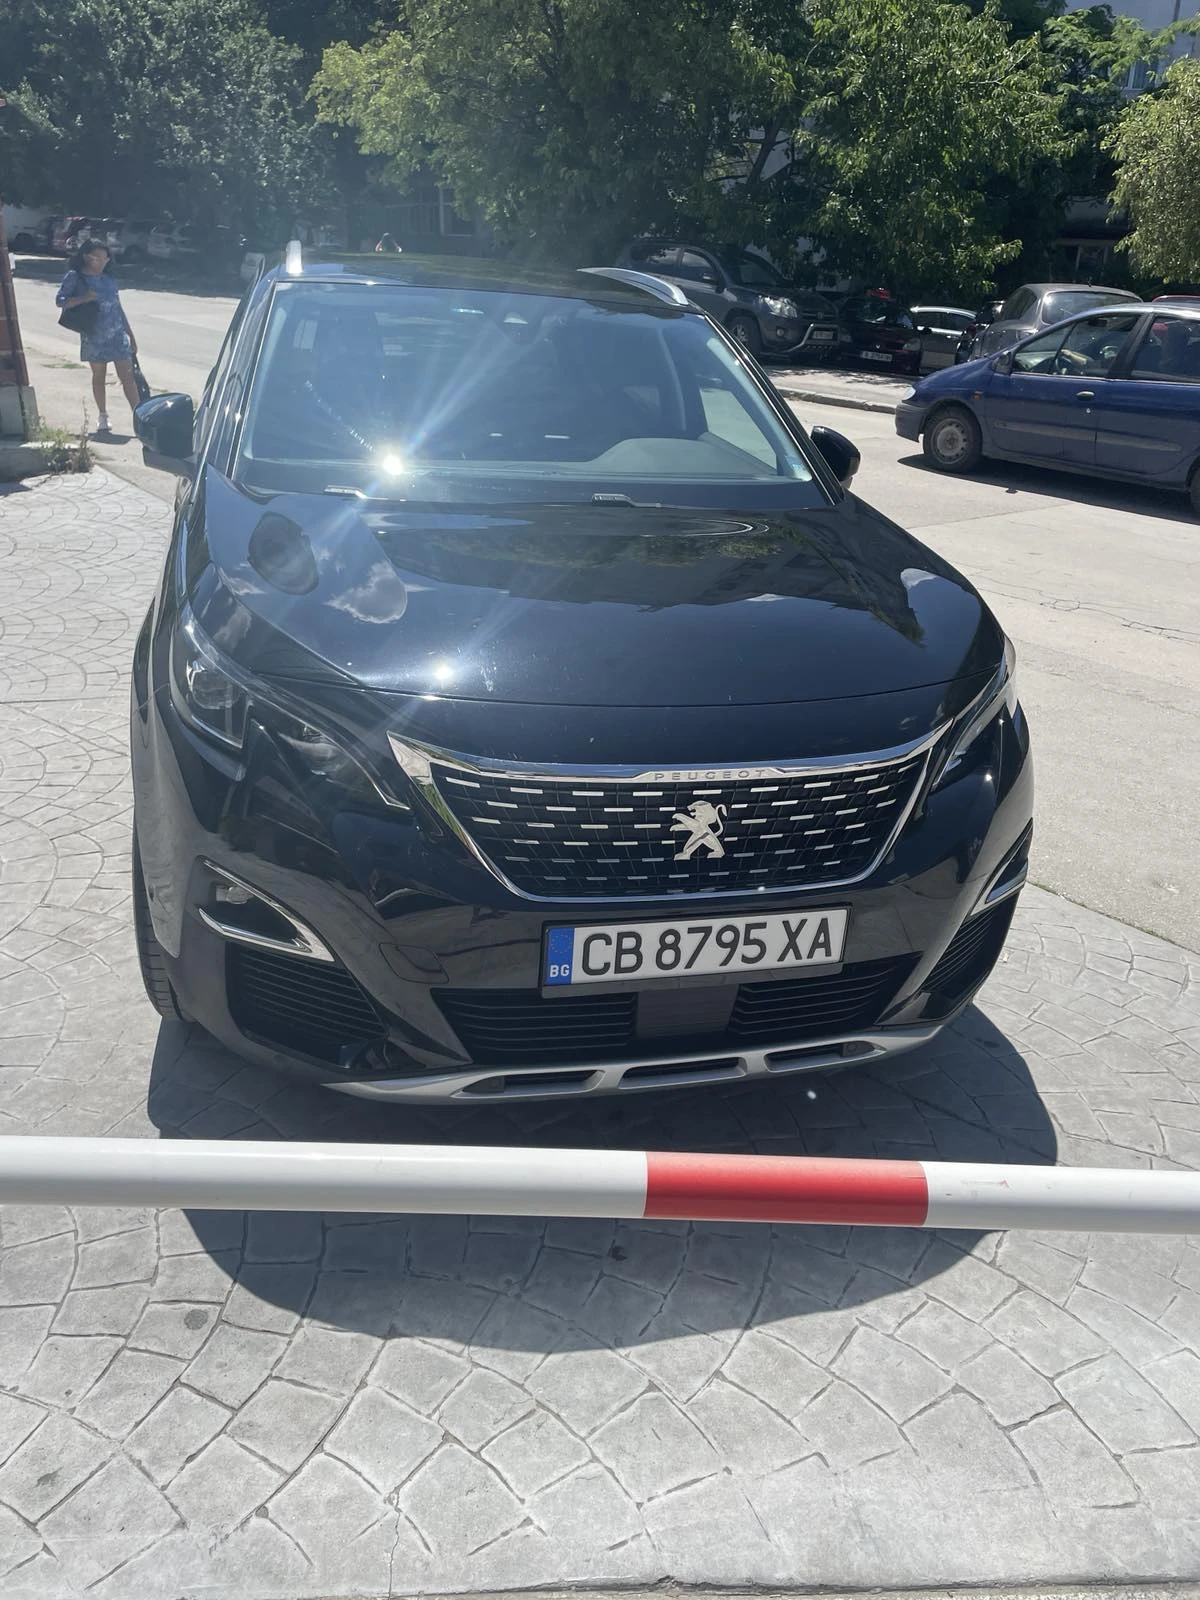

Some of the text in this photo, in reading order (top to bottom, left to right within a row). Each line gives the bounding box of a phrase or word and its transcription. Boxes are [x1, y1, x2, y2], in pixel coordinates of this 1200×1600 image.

[654, 769, 765, 781] PEUGEOT
[581, 917, 832, 976] CB 8795 XA
[549, 964, 570, 978] BG
